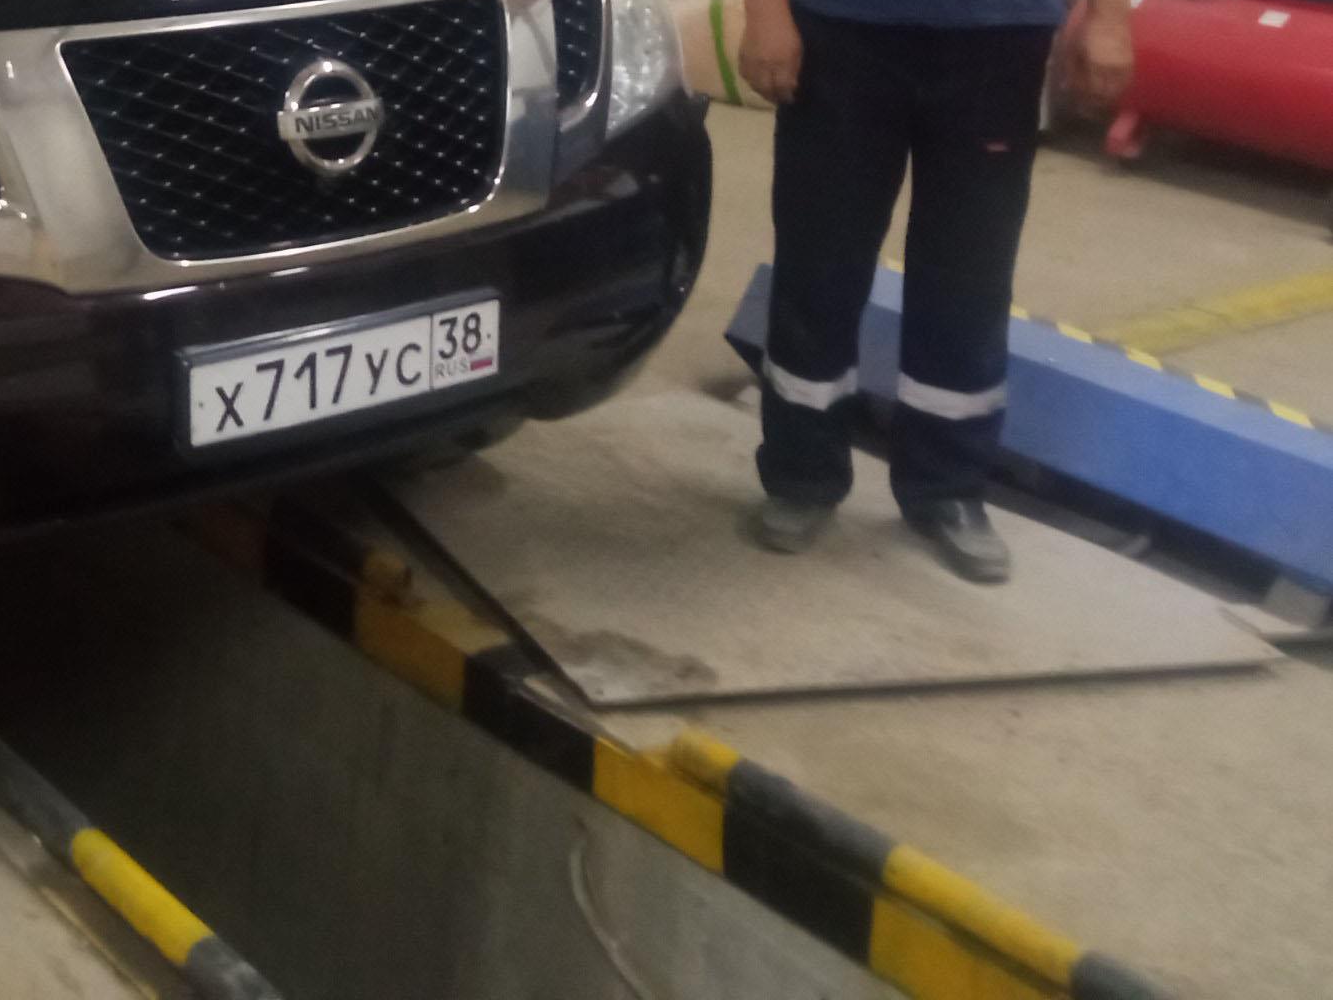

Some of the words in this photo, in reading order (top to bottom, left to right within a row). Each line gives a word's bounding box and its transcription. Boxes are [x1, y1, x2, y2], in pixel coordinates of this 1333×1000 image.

[294, 103, 382, 134] NISSAN
[438, 312, 482, 360] 38
[434, 358, 469, 378] RUS
